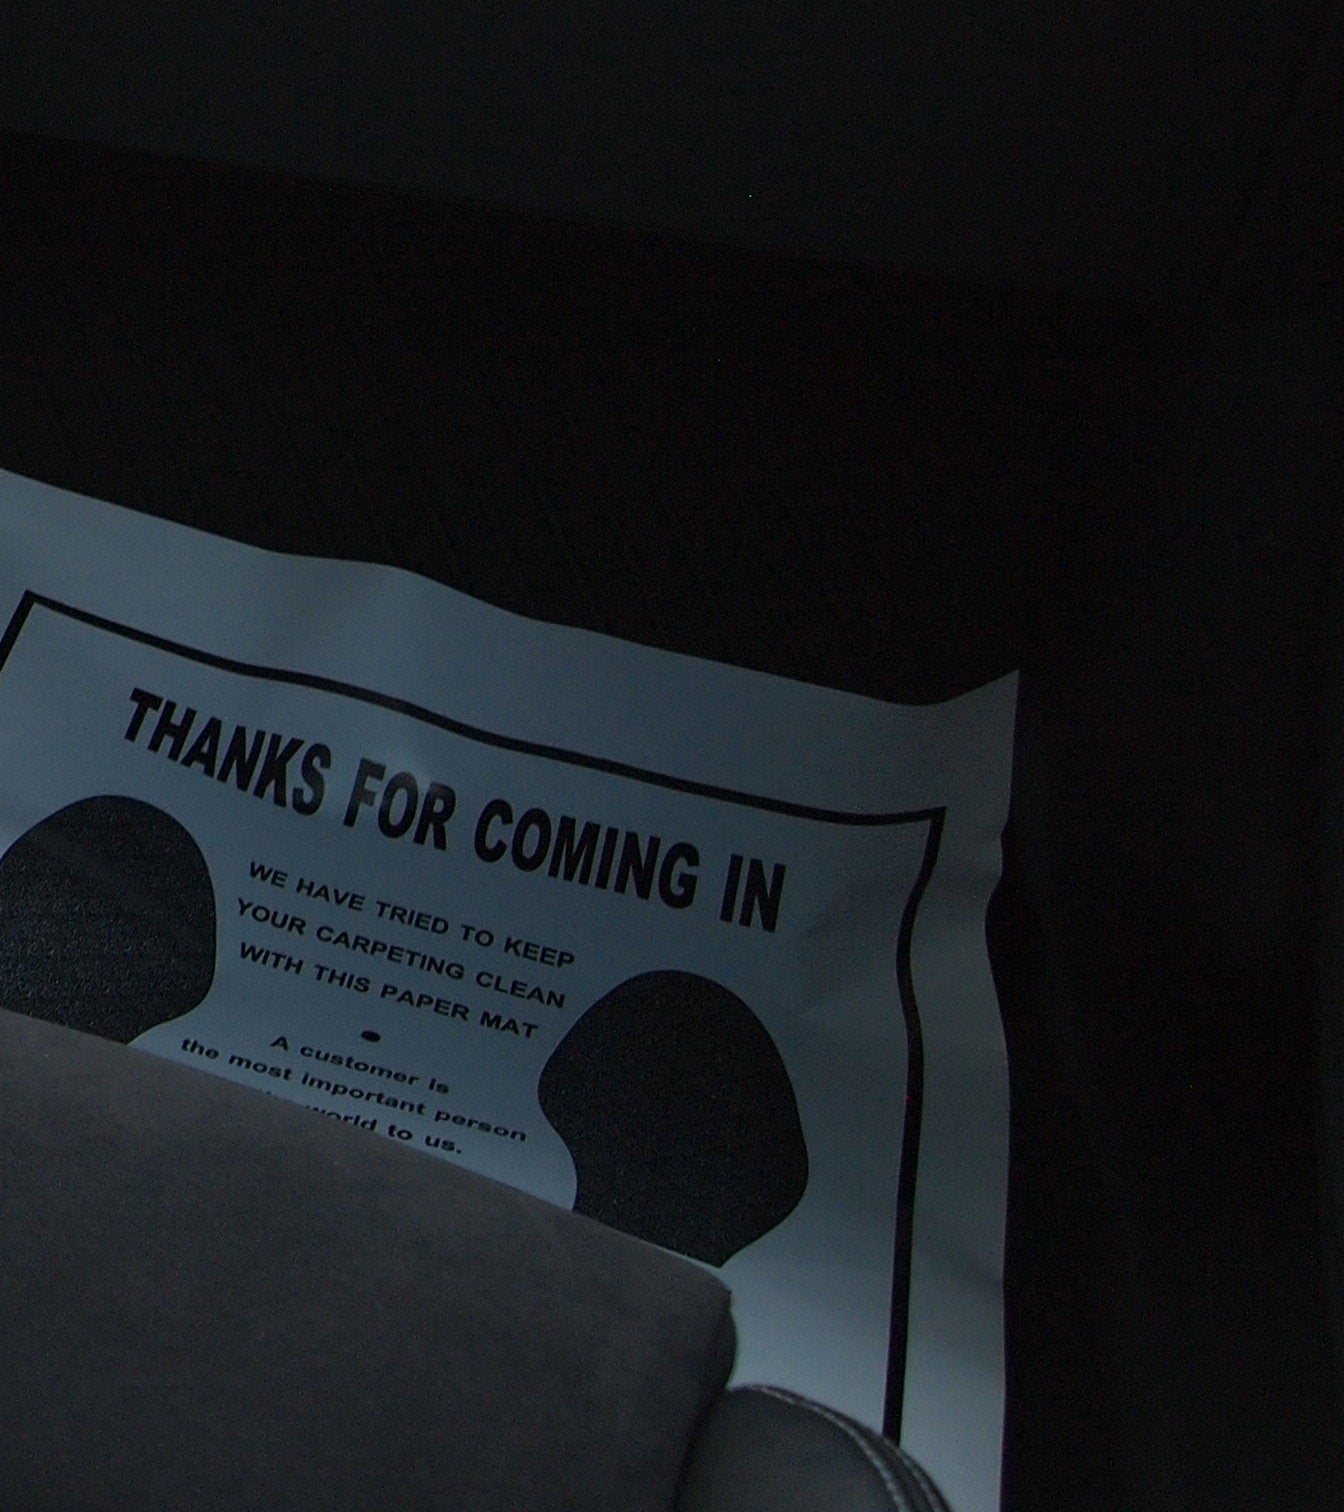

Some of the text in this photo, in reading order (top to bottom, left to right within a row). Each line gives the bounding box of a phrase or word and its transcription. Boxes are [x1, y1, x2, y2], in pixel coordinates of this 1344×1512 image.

[124, 687, 786, 933] THANKS FOR COMING IN
[238, 898, 565, 1009] YOUR CARPETING CLEAN
[249, 860, 575, 969] WE HAVE TRIED TO KEEP
[240, 942, 539, 1039] WITH THIS PAPER MAT
[180, 1037, 219, 1060] the
[228, 1052, 292, 1081] most
[301, 1072, 427, 1116] important
[434, 1108, 528, 1143] person
[270, 1036, 450, 1095] A customer is
[387, 1123, 414, 1142] to
[424, 1134, 463, 1155] us.
